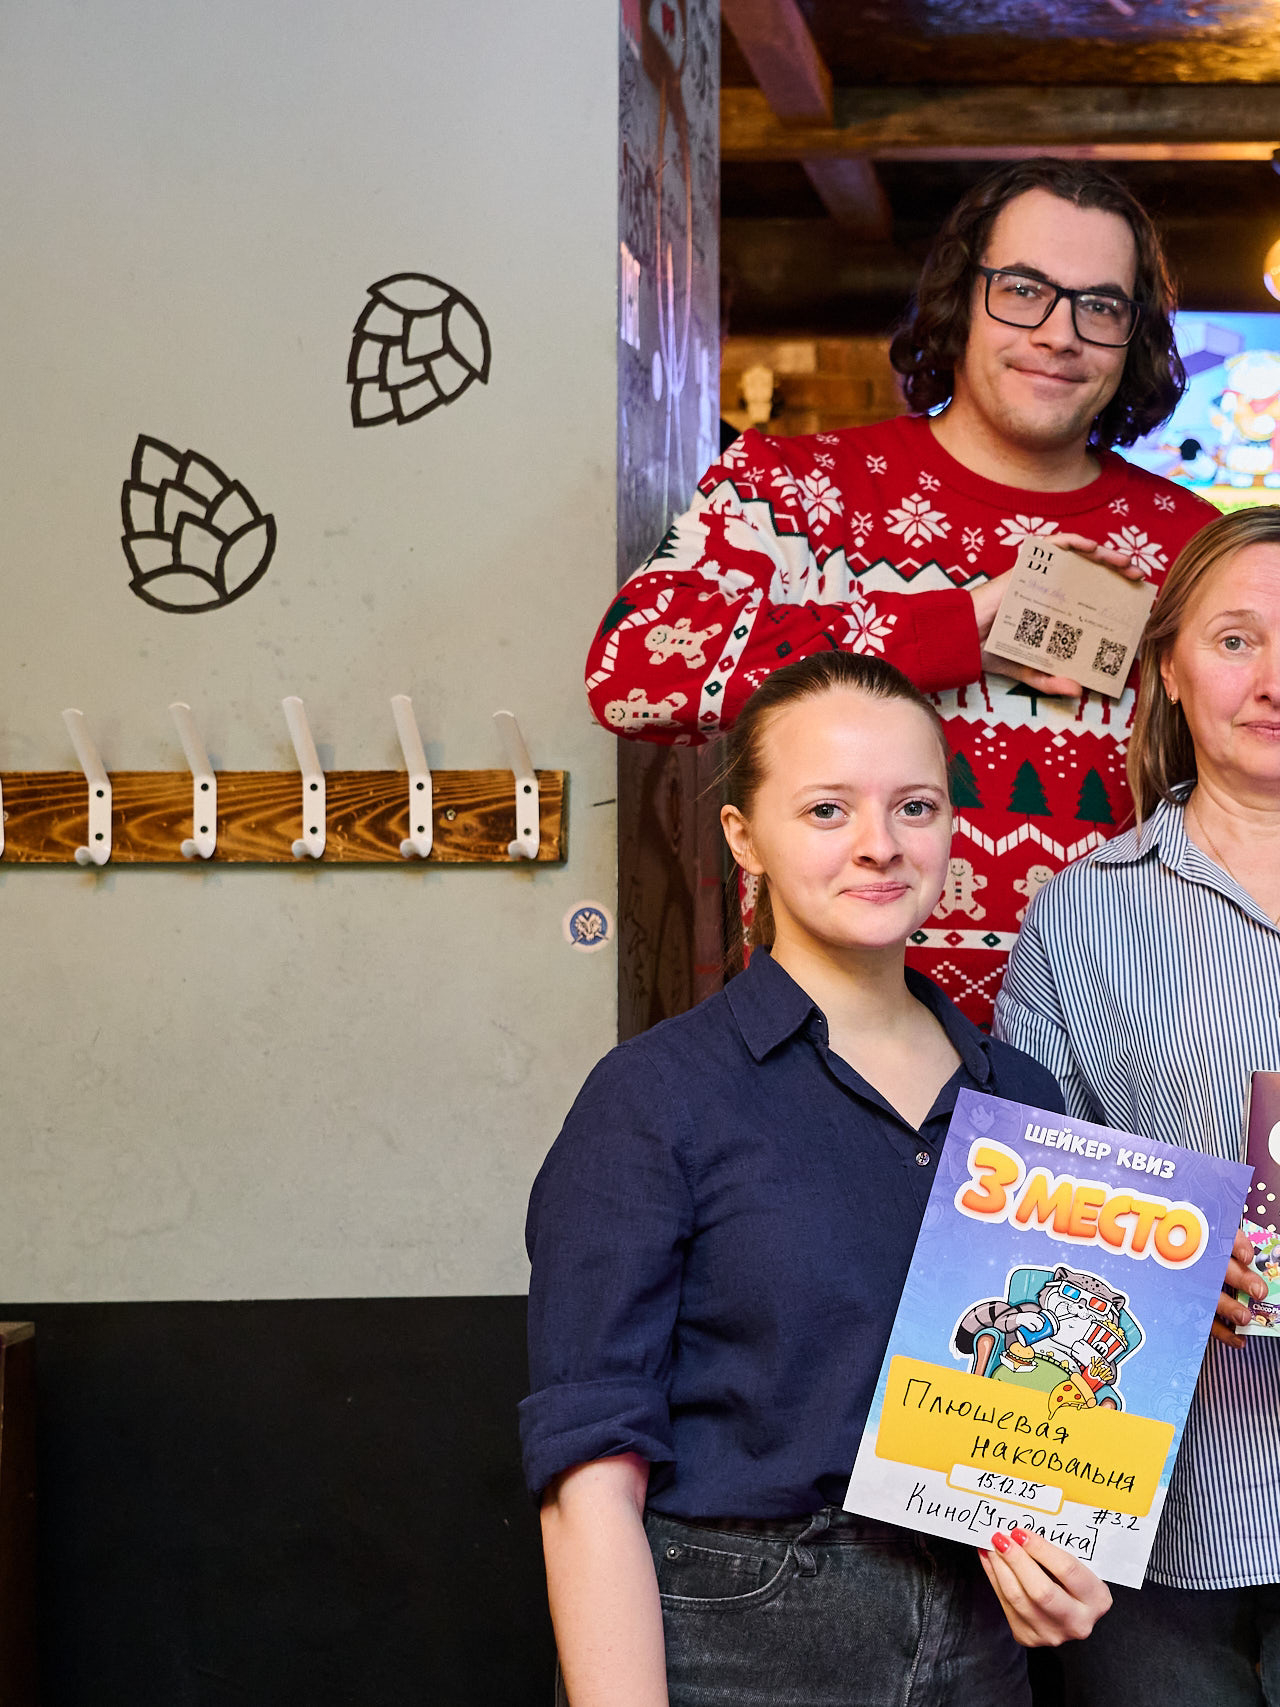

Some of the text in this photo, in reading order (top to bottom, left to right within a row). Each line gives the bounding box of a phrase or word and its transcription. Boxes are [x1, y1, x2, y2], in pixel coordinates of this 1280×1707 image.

[1025, 1123, 1176, 1179] ШЕЙКЕР КВИЗ
[962, 1146, 1202, 1264] 3 МЕСТО
[902, 1377, 1070, 1445] Плюшевая
[970, 1437, 1138, 1494] наковальня
[976, 1470, 1046, 1500] 15.12.25
[1092, 1508, 1142, 1532] #3.2
